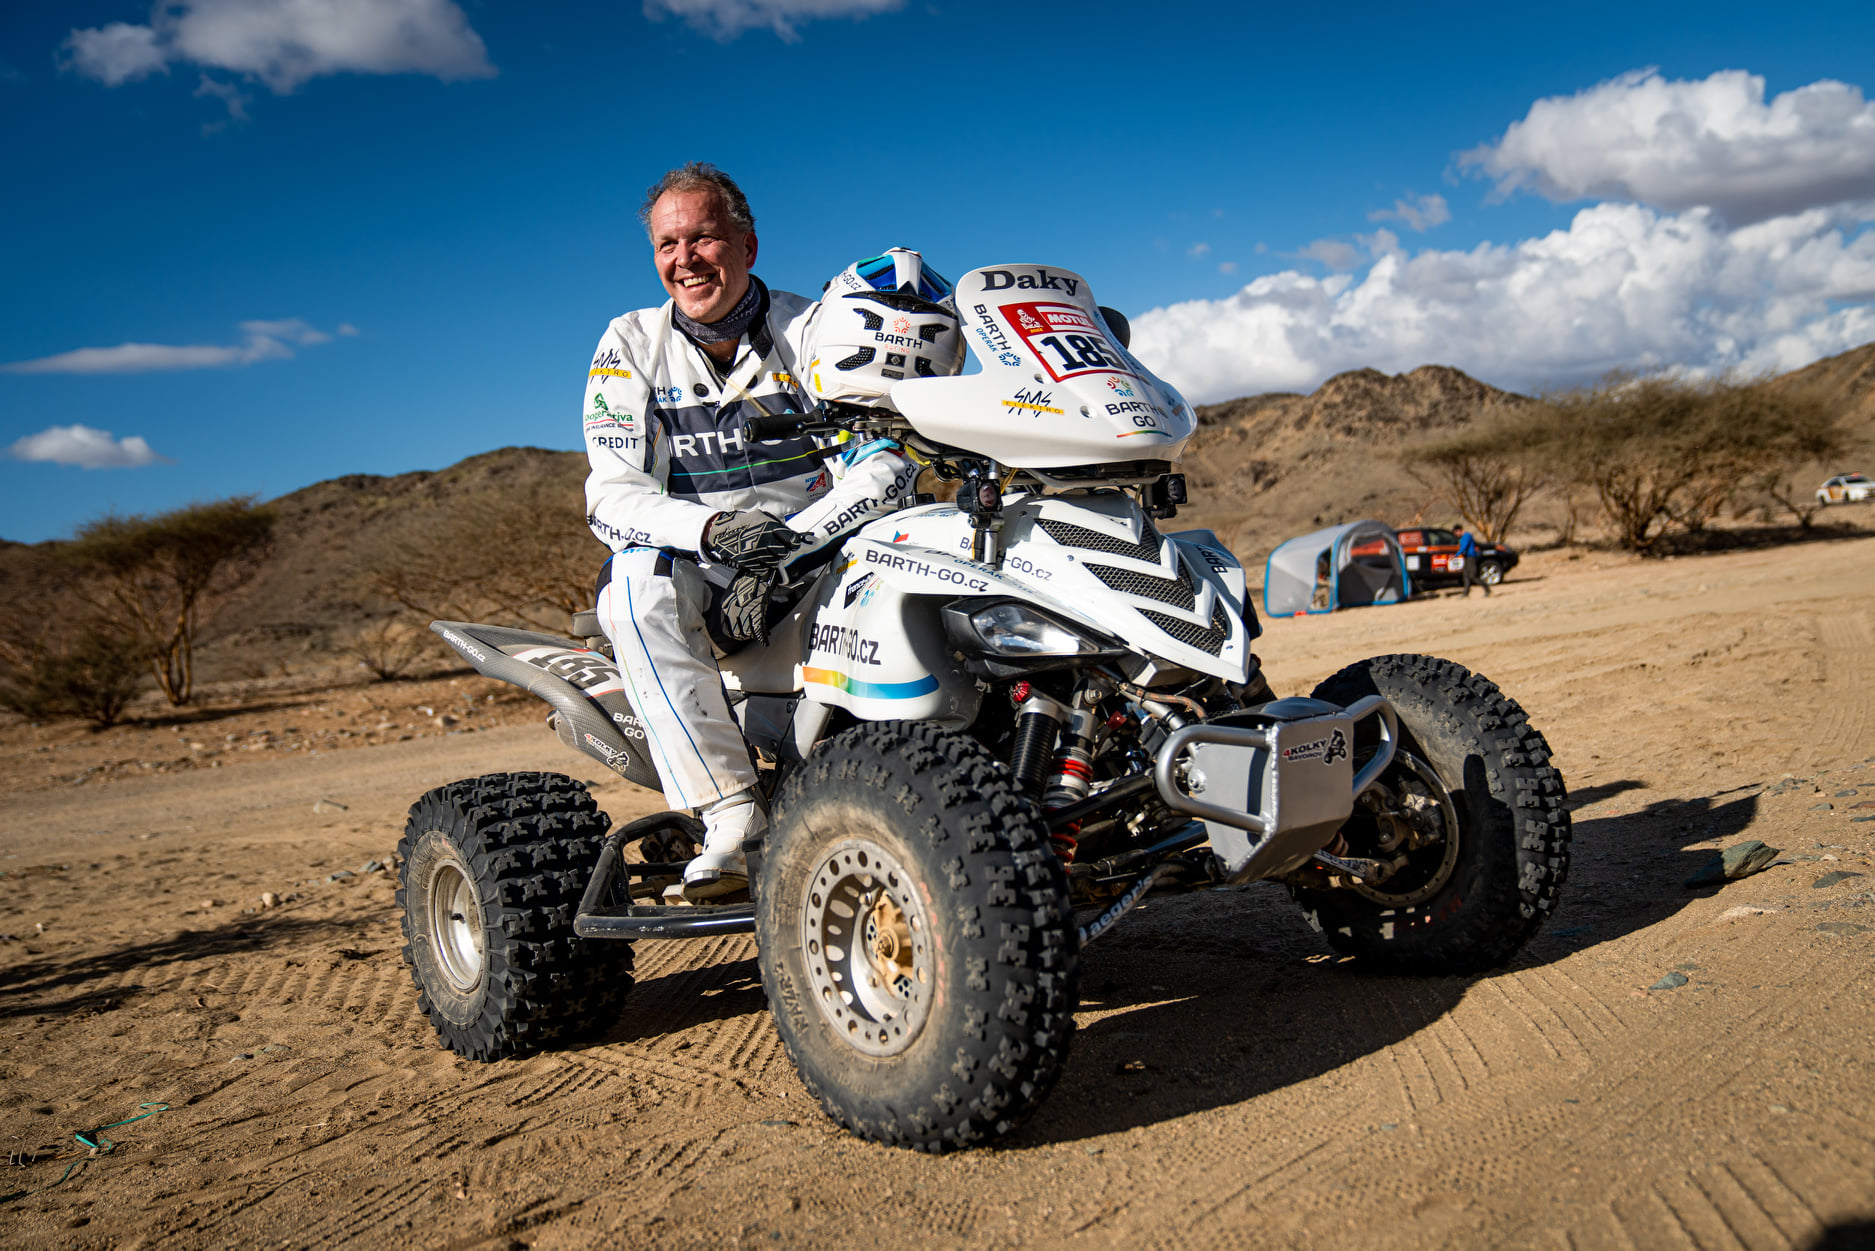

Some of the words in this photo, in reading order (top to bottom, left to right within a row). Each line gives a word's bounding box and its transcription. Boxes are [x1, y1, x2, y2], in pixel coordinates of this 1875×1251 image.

[979, 269, 1079, 297] Daky
[973, 303, 1012, 351] BARTH
[1048, 313, 1094, 328] MOTUL
[874, 331, 923, 350] BARTH
[1039, 333, 1128, 372] 185
[1007, 386, 1053, 418] SMS
[1104, 401, 1160, 416] BARTH
[1132, 415, 1157, 428] GO
[527, 650, 622, 691] 185
[623, 726, 646, 740] GO
